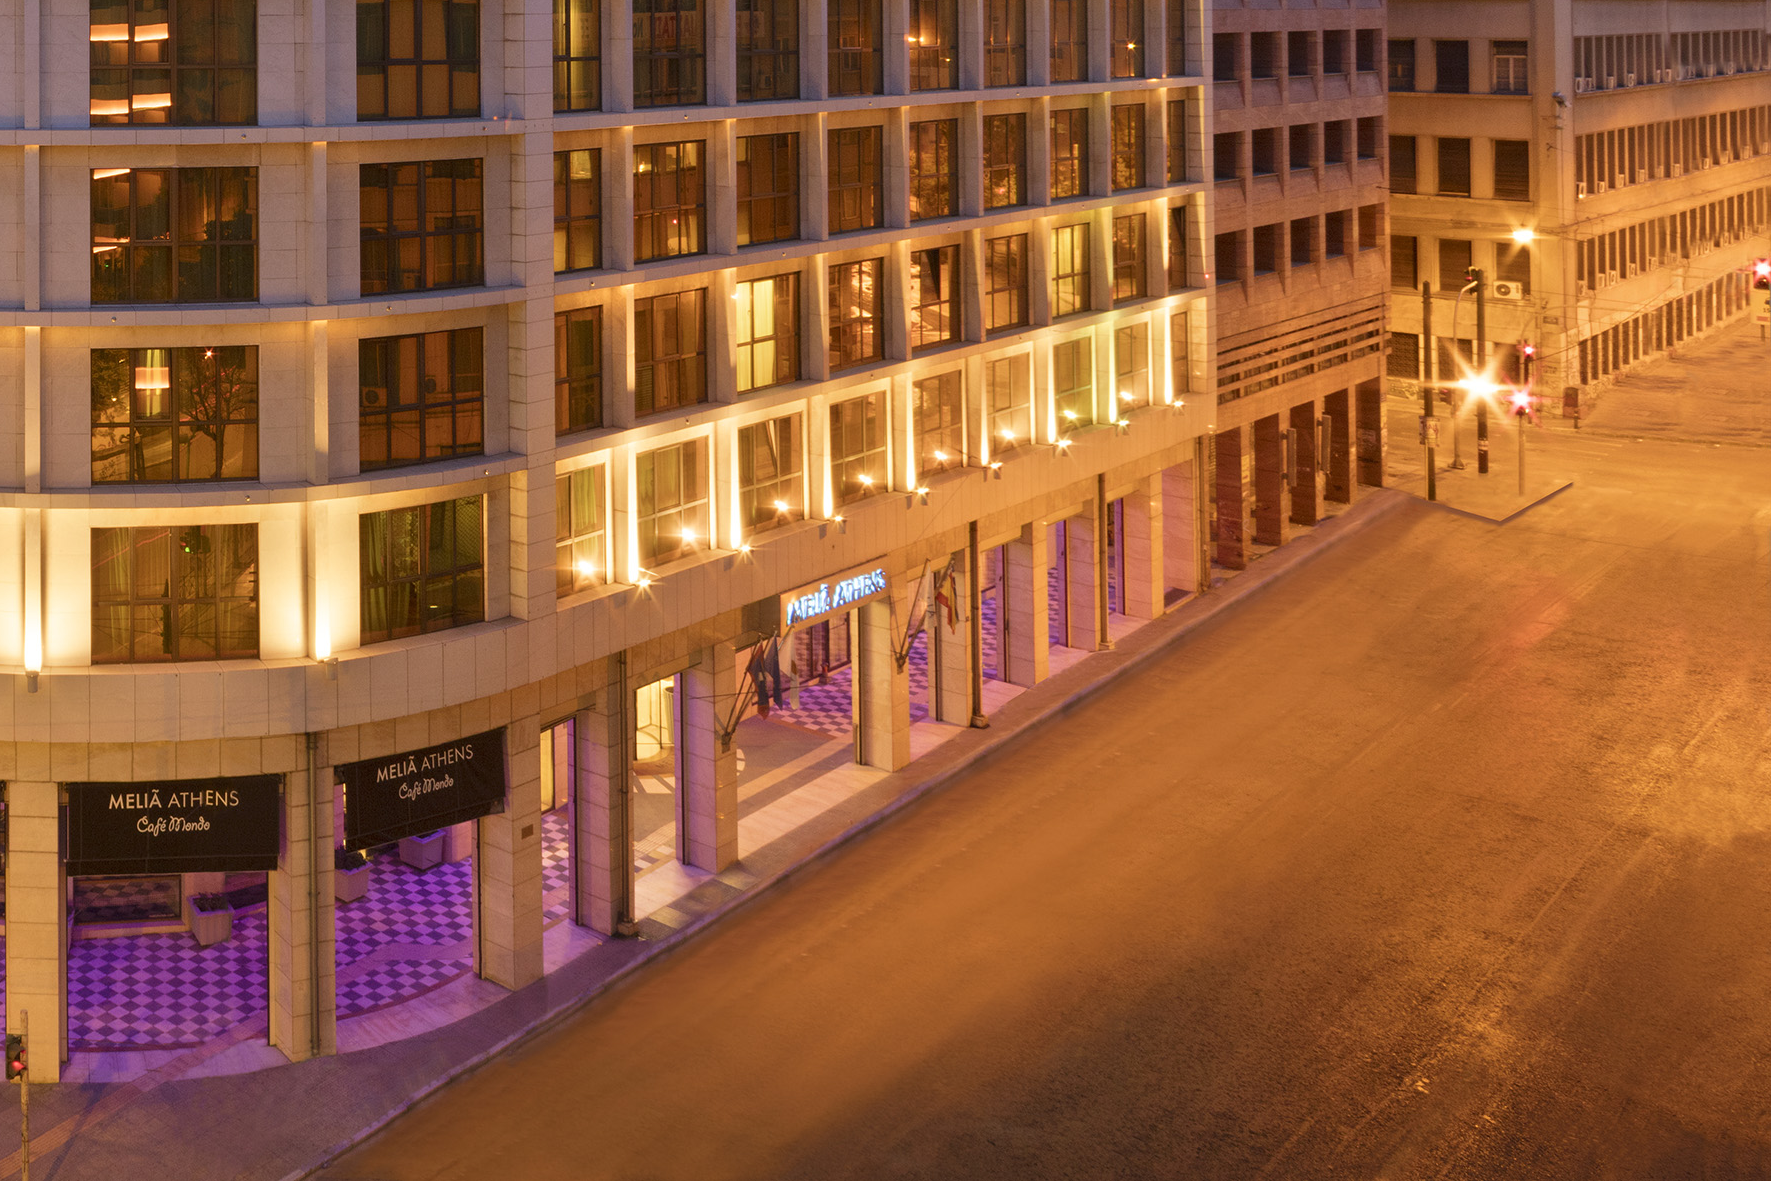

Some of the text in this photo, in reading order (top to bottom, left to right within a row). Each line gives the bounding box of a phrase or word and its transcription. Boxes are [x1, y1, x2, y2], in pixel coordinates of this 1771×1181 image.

[376, 744, 474, 783] MELIÃ ATHENS
[108, 789, 239, 810] MELIÃ ATHENS
[398, 773, 454, 801] Café Mondo
[136, 815, 211, 837] Café Mondo
